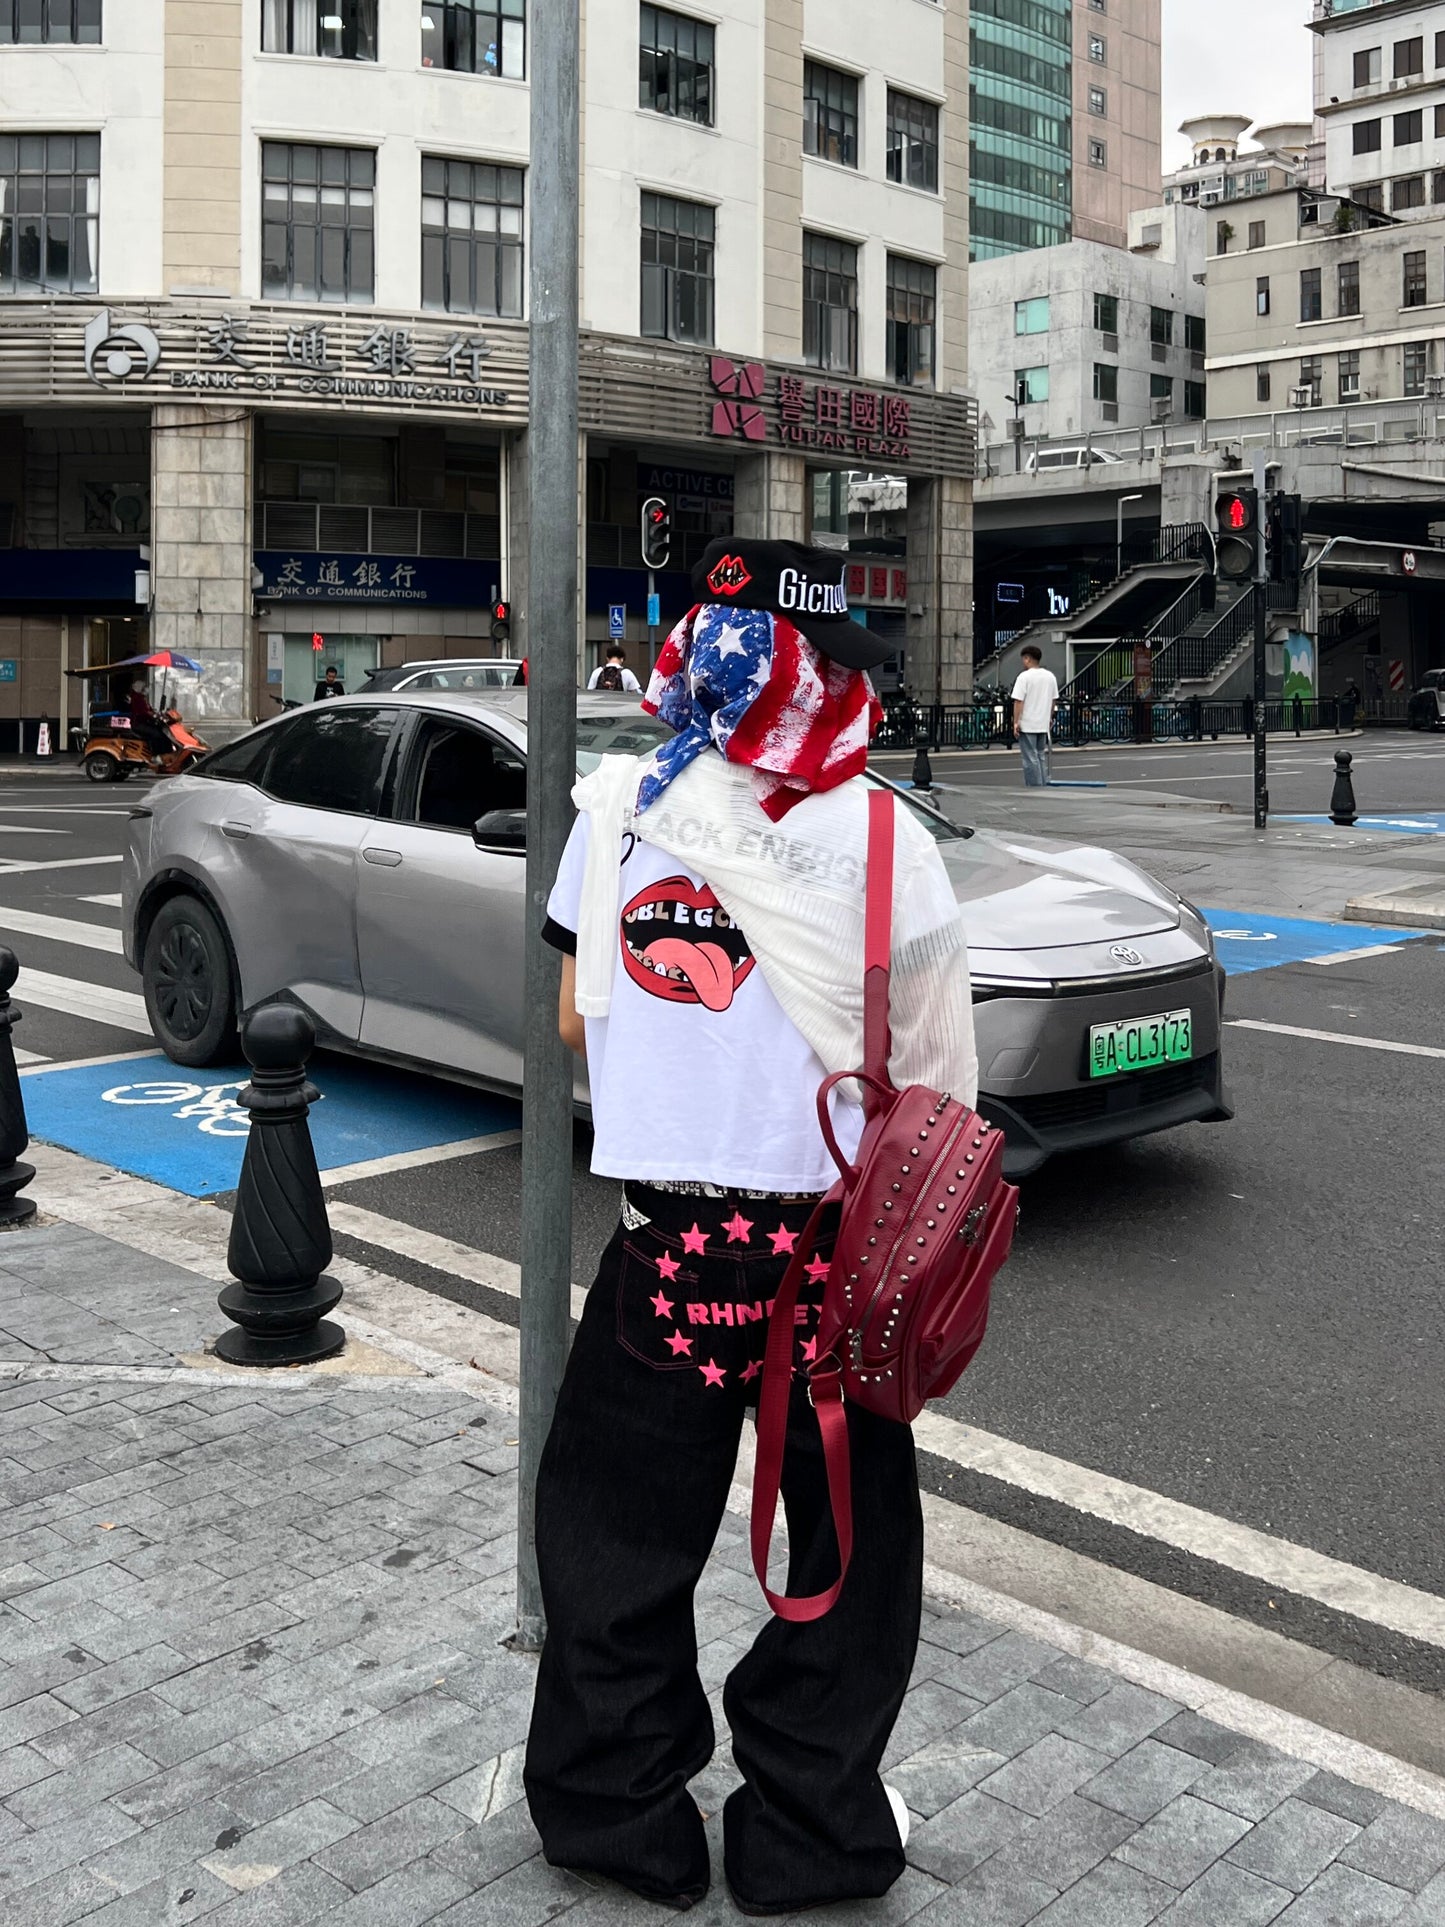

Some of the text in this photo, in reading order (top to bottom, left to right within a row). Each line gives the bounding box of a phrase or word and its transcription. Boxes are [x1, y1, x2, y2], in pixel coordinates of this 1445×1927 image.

[205, 312, 492, 383] 交通銀行
[170, 371, 509, 406] BANK OF COMMUNICATIONS
[778, 374, 911, 439] 譽田國際
[776, 425, 912, 457] YUTIAN PLAZA
[649, 469, 713, 493] ACTIVE
[277, 558, 417, 588] 交通銀行
[306, 587, 322, 596] OF
[328, 588, 427, 600] COMMUNICATIONS
